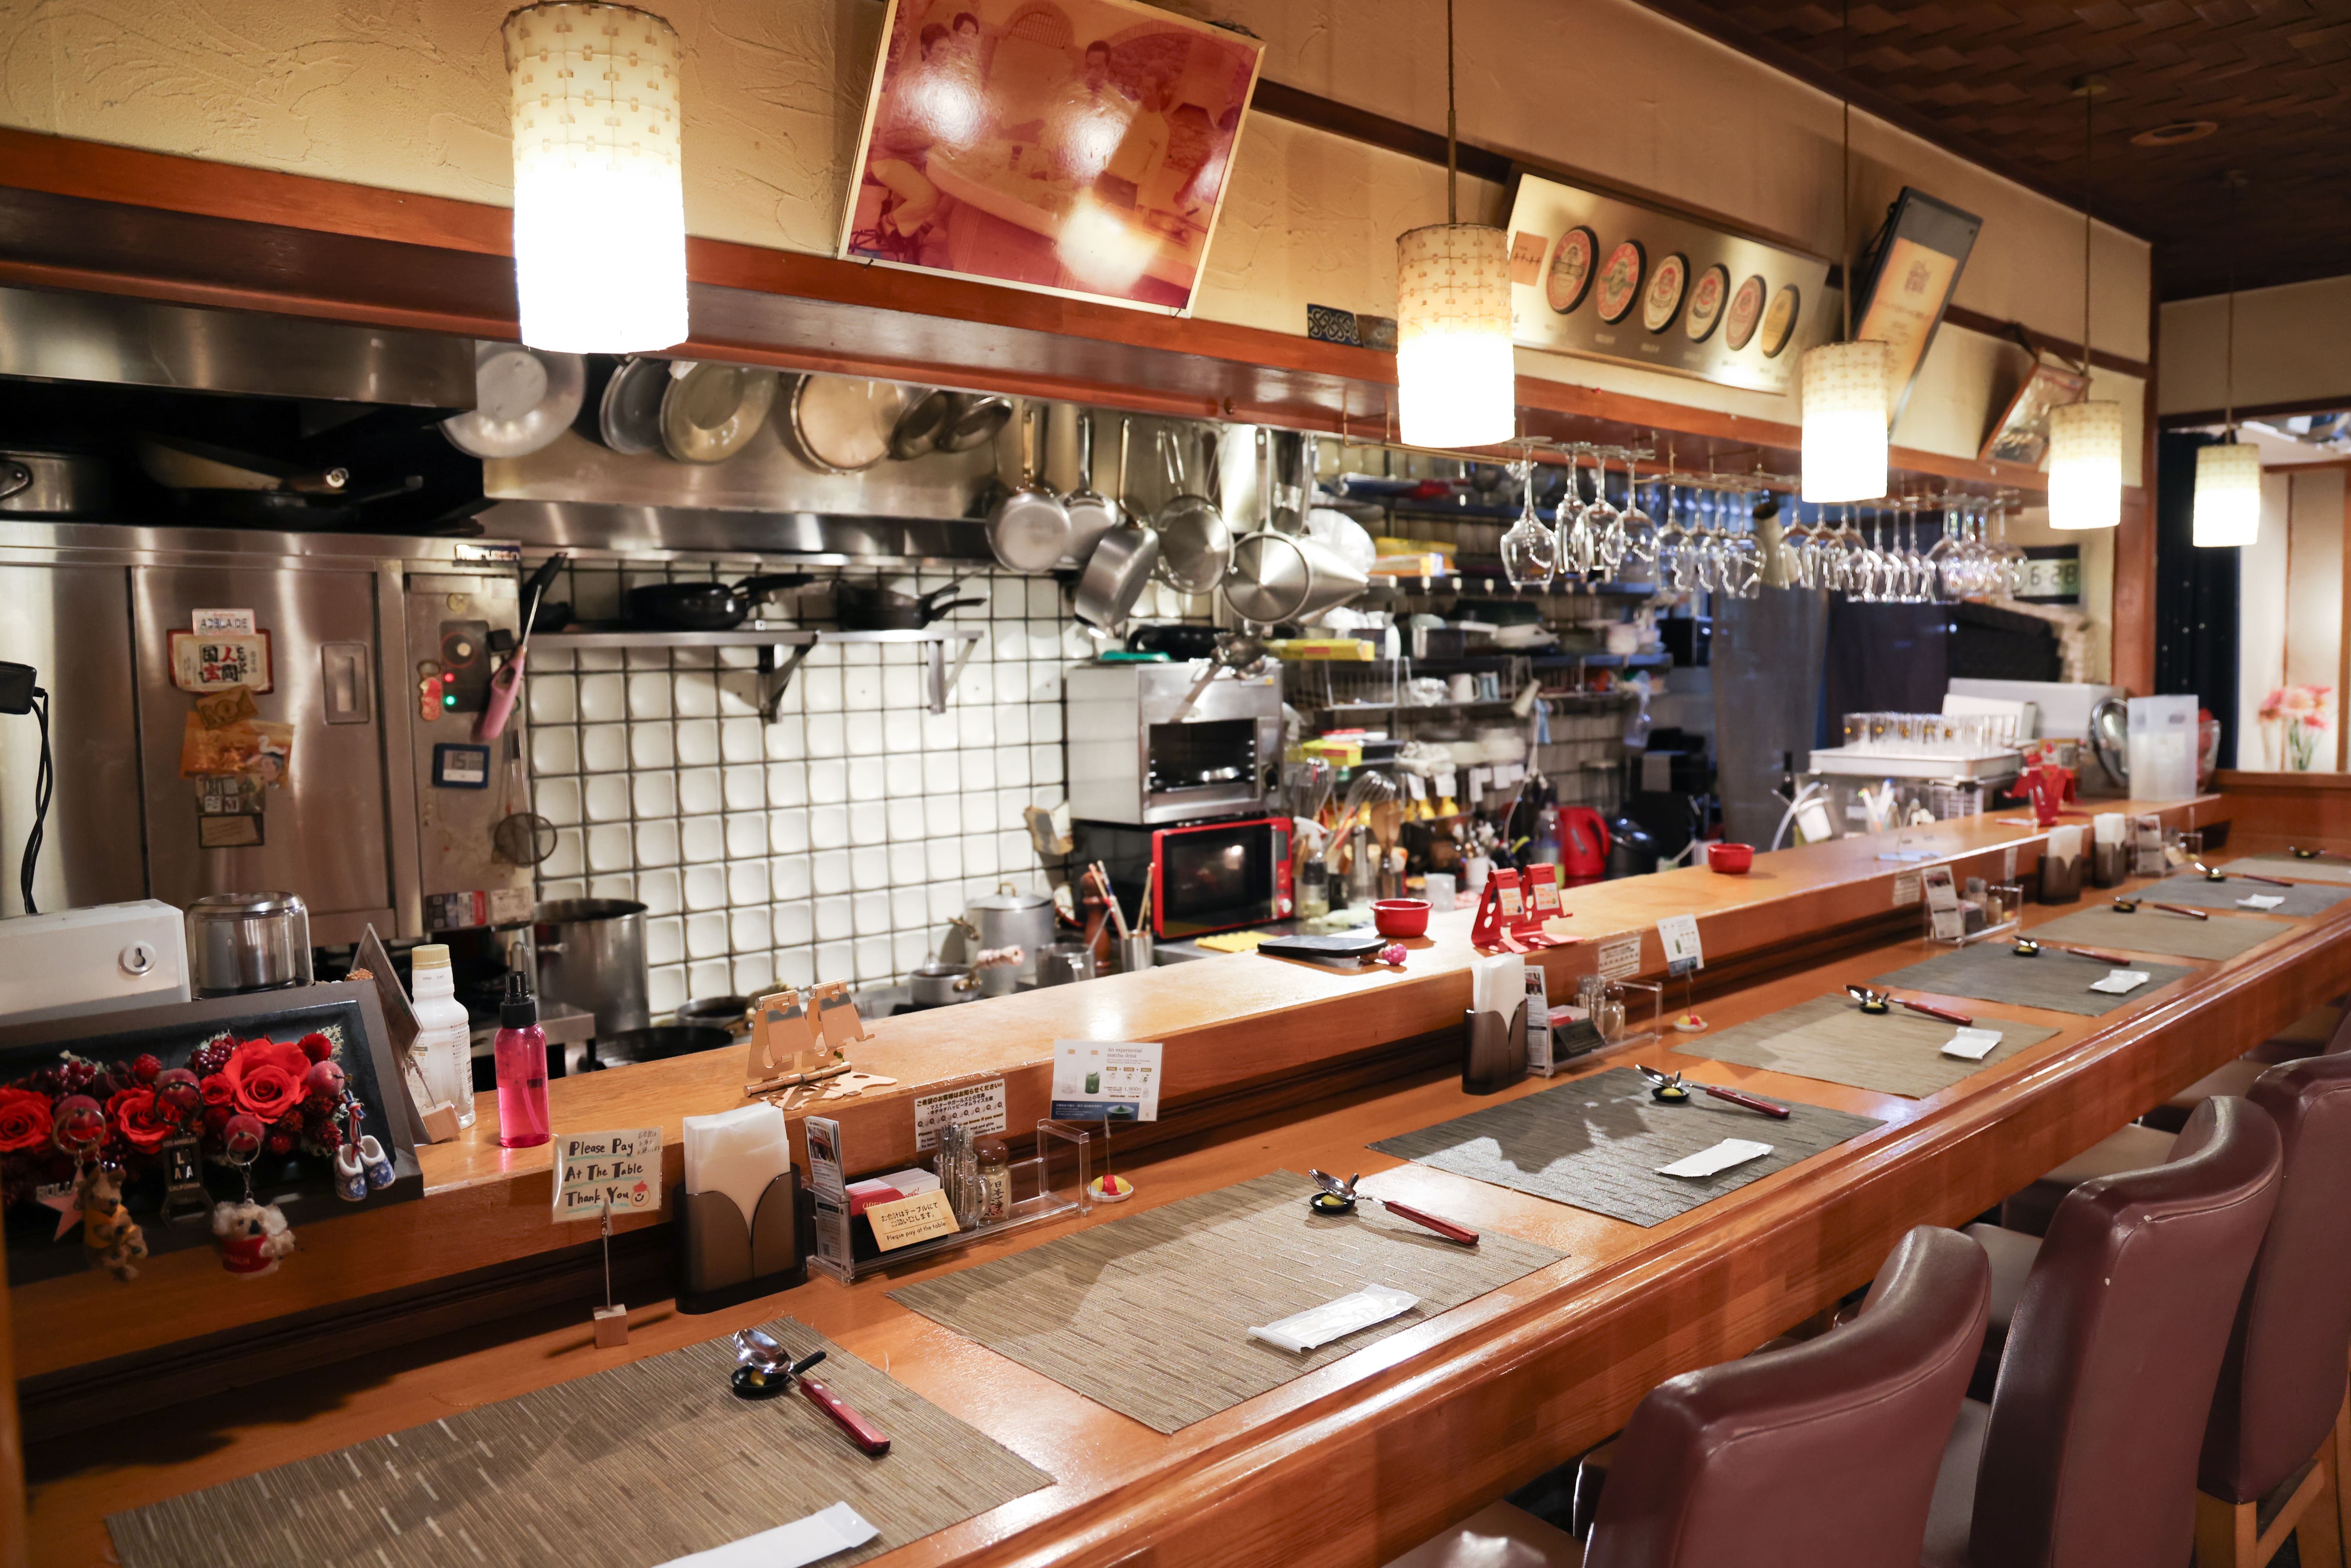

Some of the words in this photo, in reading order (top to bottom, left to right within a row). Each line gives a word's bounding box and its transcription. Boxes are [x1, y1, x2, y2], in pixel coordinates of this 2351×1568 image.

[569, 1141, 605, 1156] Please
[612, 1138, 633, 1156] Pay
[565, 1166, 582, 1181] At
[587, 1164, 608, 1180] The
[612, 1161, 643, 1178] Table
[565, 1188, 600, 1206] Thank
[607, 1186, 629, 1204] You
[887, 1233, 904, 1241] Please
[906, 1230, 916, 1239] pay
